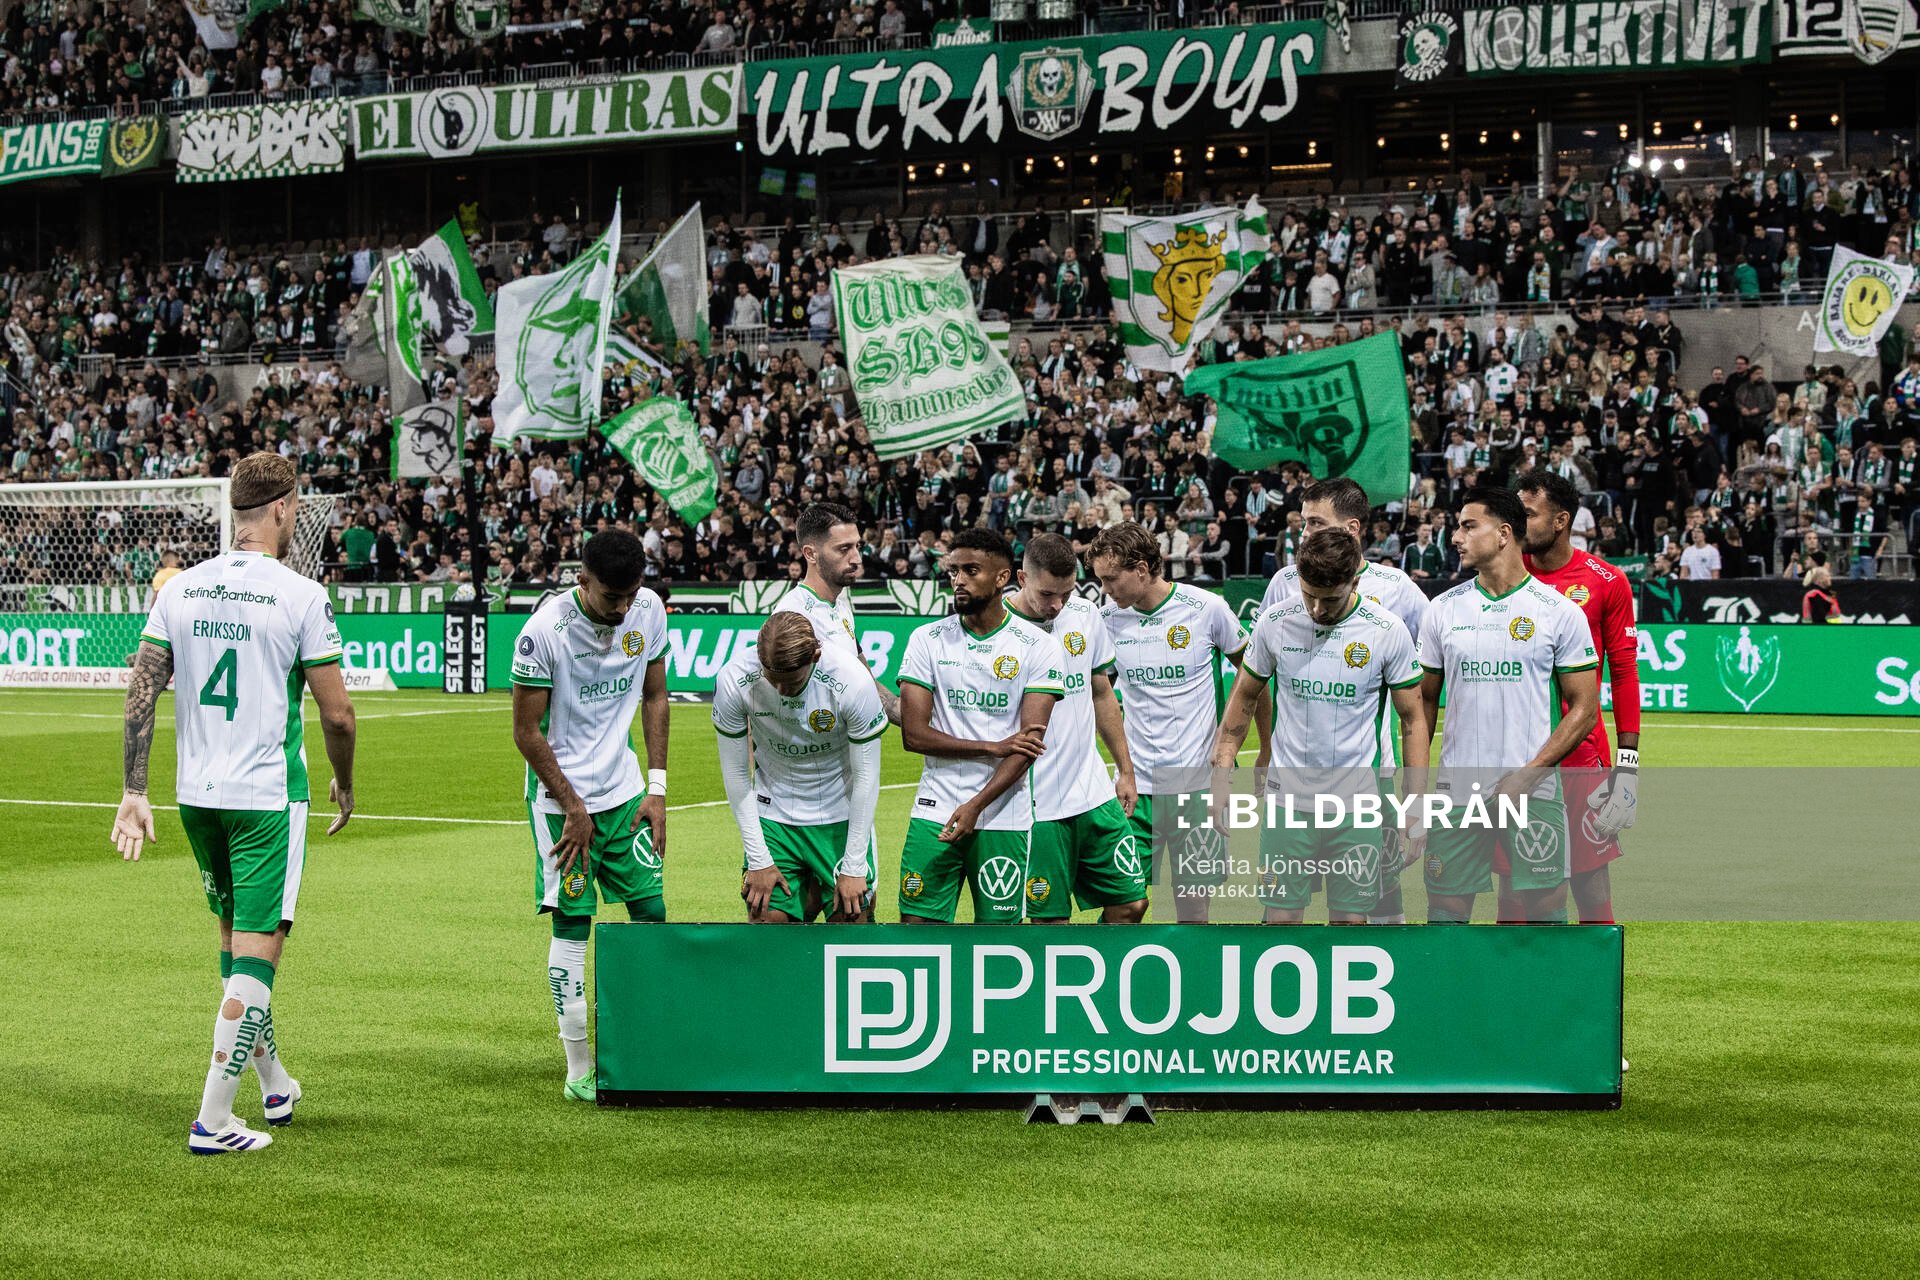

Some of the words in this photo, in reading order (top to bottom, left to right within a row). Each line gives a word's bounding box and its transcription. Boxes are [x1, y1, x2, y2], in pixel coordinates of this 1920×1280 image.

[1463, 0, 1769, 71] KOLLEKTIVET
[493, 70, 734, 141] ULTRAS
[754, 52, 1001, 156] ULTRA
[1097, 31, 1314, 133] BOYS
[0, 120, 87, 173] FANS
[1368, 567, 1401, 583] sesol
[1585, 558, 1616, 582] sesol
[183, 587, 217, 599] Sefina
[222, 591, 278, 606] pantbank
[1174, 592, 1208, 611] sesol
[1526, 585, 1560, 607] sesol
[193, 620, 251, 641] ERIKSSON
[1357, 607, 1394, 631] sesol
[0, 628, 84, 666] ORT
[1008, 625, 1040, 647] sesol
[446, 614, 464, 692] SELECT
[471, 614, 485, 692] SELECT
[3, 669, 49, 683] Handla
[52, 670, 91, 683] online
[1127, 665, 1186, 682] PROJOB
[1461, 661, 1522, 676] PROJOB
[200, 649, 238, 721] 4
[813, 669, 848, 694] sesol
[1291, 678, 1357, 698] PROJOB
[947, 689, 1009, 707] PROJOB
[973, 944, 1395, 1036] PROJOB
[225, 1005, 265, 1079] Clinton
[973, 1048, 1204, 1074] PROFESSIONAL
[1213, 1048, 1395, 1074] WORKWEAR
